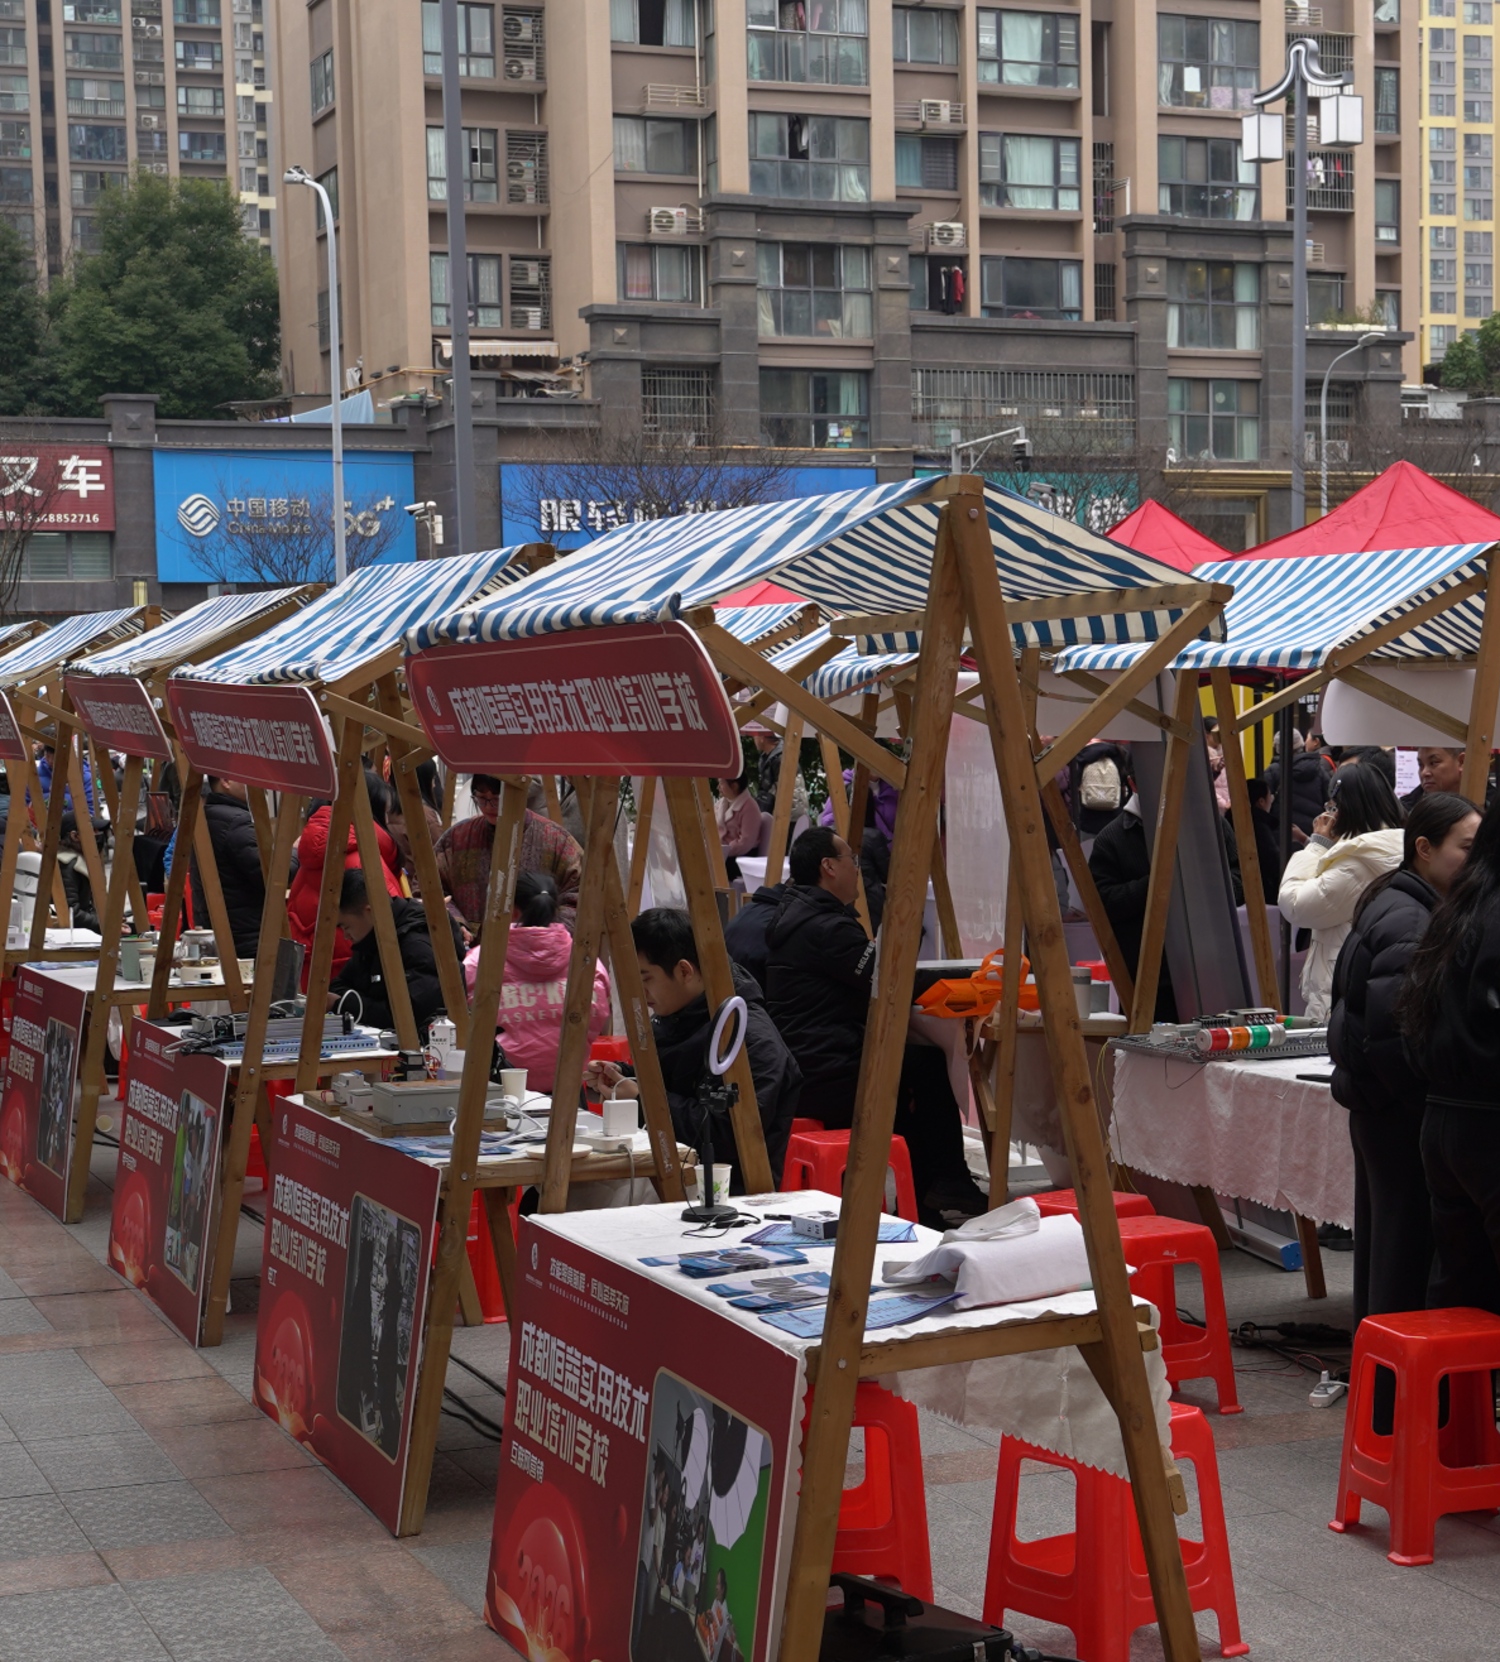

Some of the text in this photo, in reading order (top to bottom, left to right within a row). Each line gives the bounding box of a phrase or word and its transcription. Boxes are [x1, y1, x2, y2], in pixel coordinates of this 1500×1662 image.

[226, 497, 310, 518] 中国移动
[448, 672, 708, 735] 成都恒益实用技术职业培训学校
[273, 1173, 349, 1249] 成都恒益实用技术
[270, 1218, 326, 1287] 职业培训学校
[519, 1321, 649, 1443] 成都恒益实用技术
[514, 1379, 610, 1488] 职业培训学校
